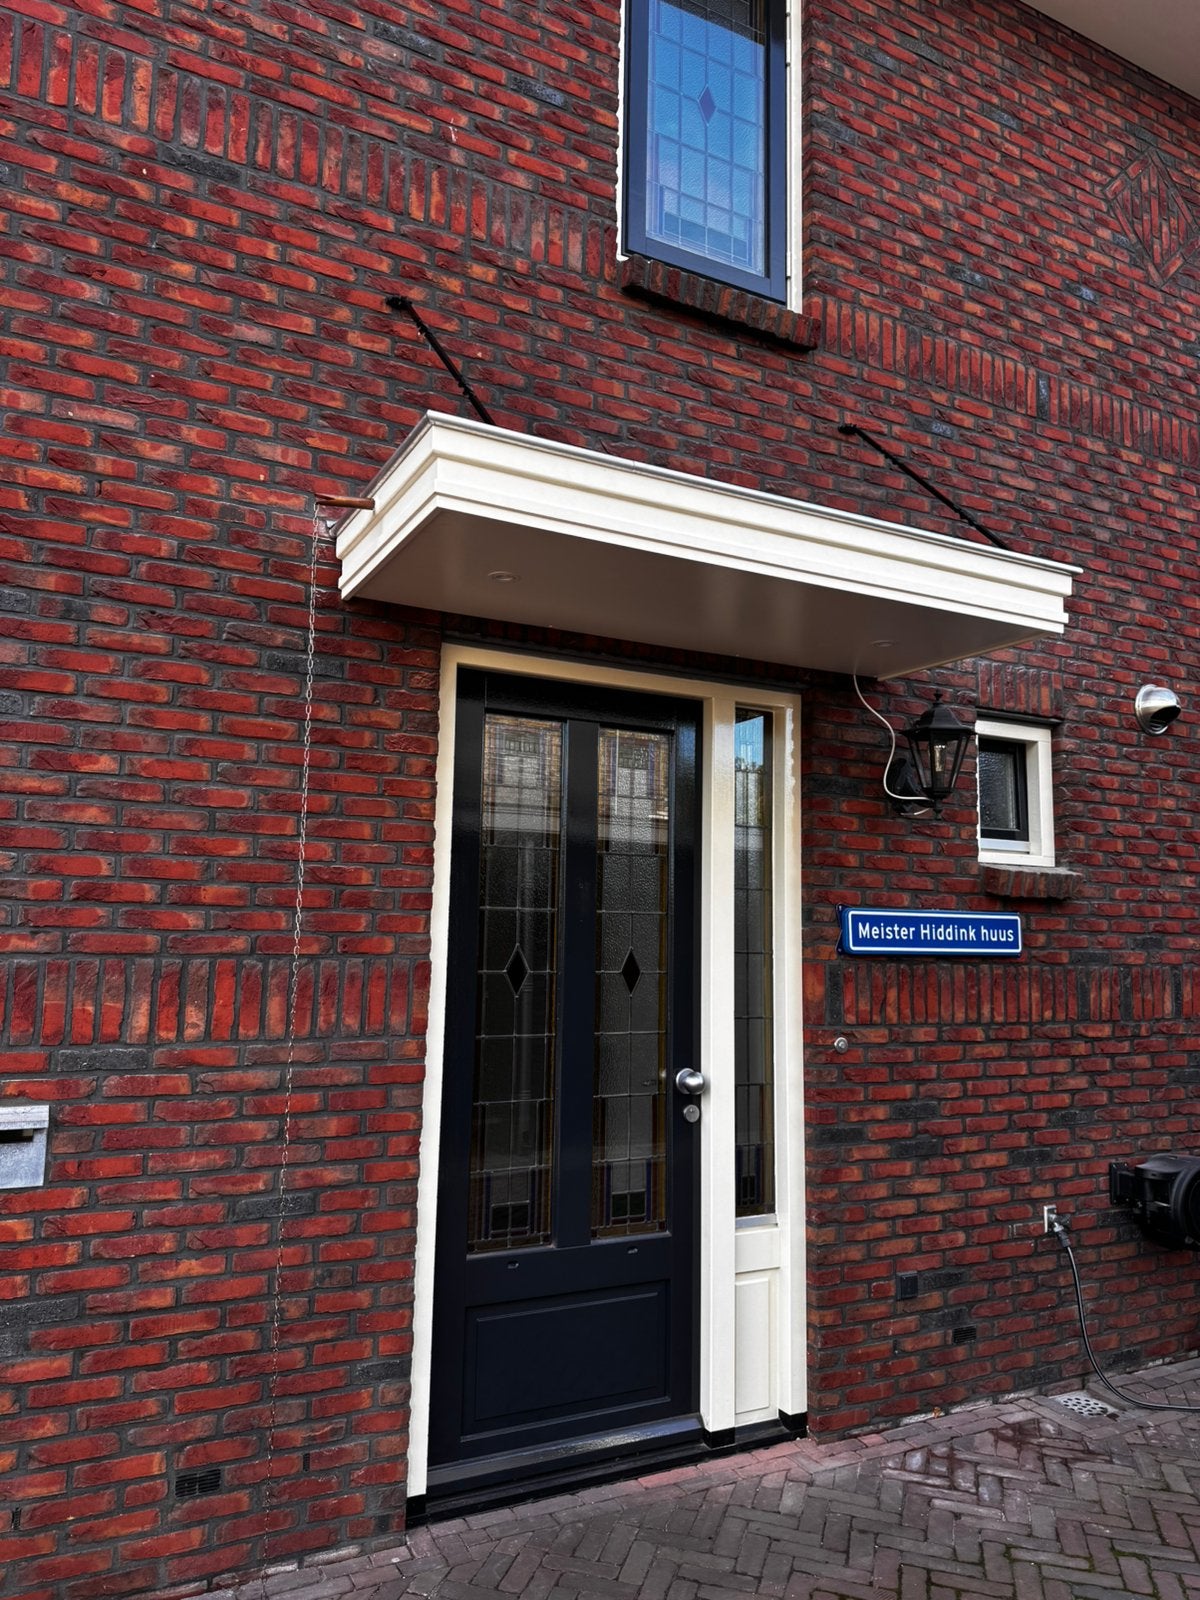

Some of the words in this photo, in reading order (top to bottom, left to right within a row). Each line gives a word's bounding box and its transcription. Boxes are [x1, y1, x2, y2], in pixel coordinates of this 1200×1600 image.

[858, 922, 915, 939] Meister
[920, 924, 976, 941] Hiddink
[981, 925, 1014, 941] huus
